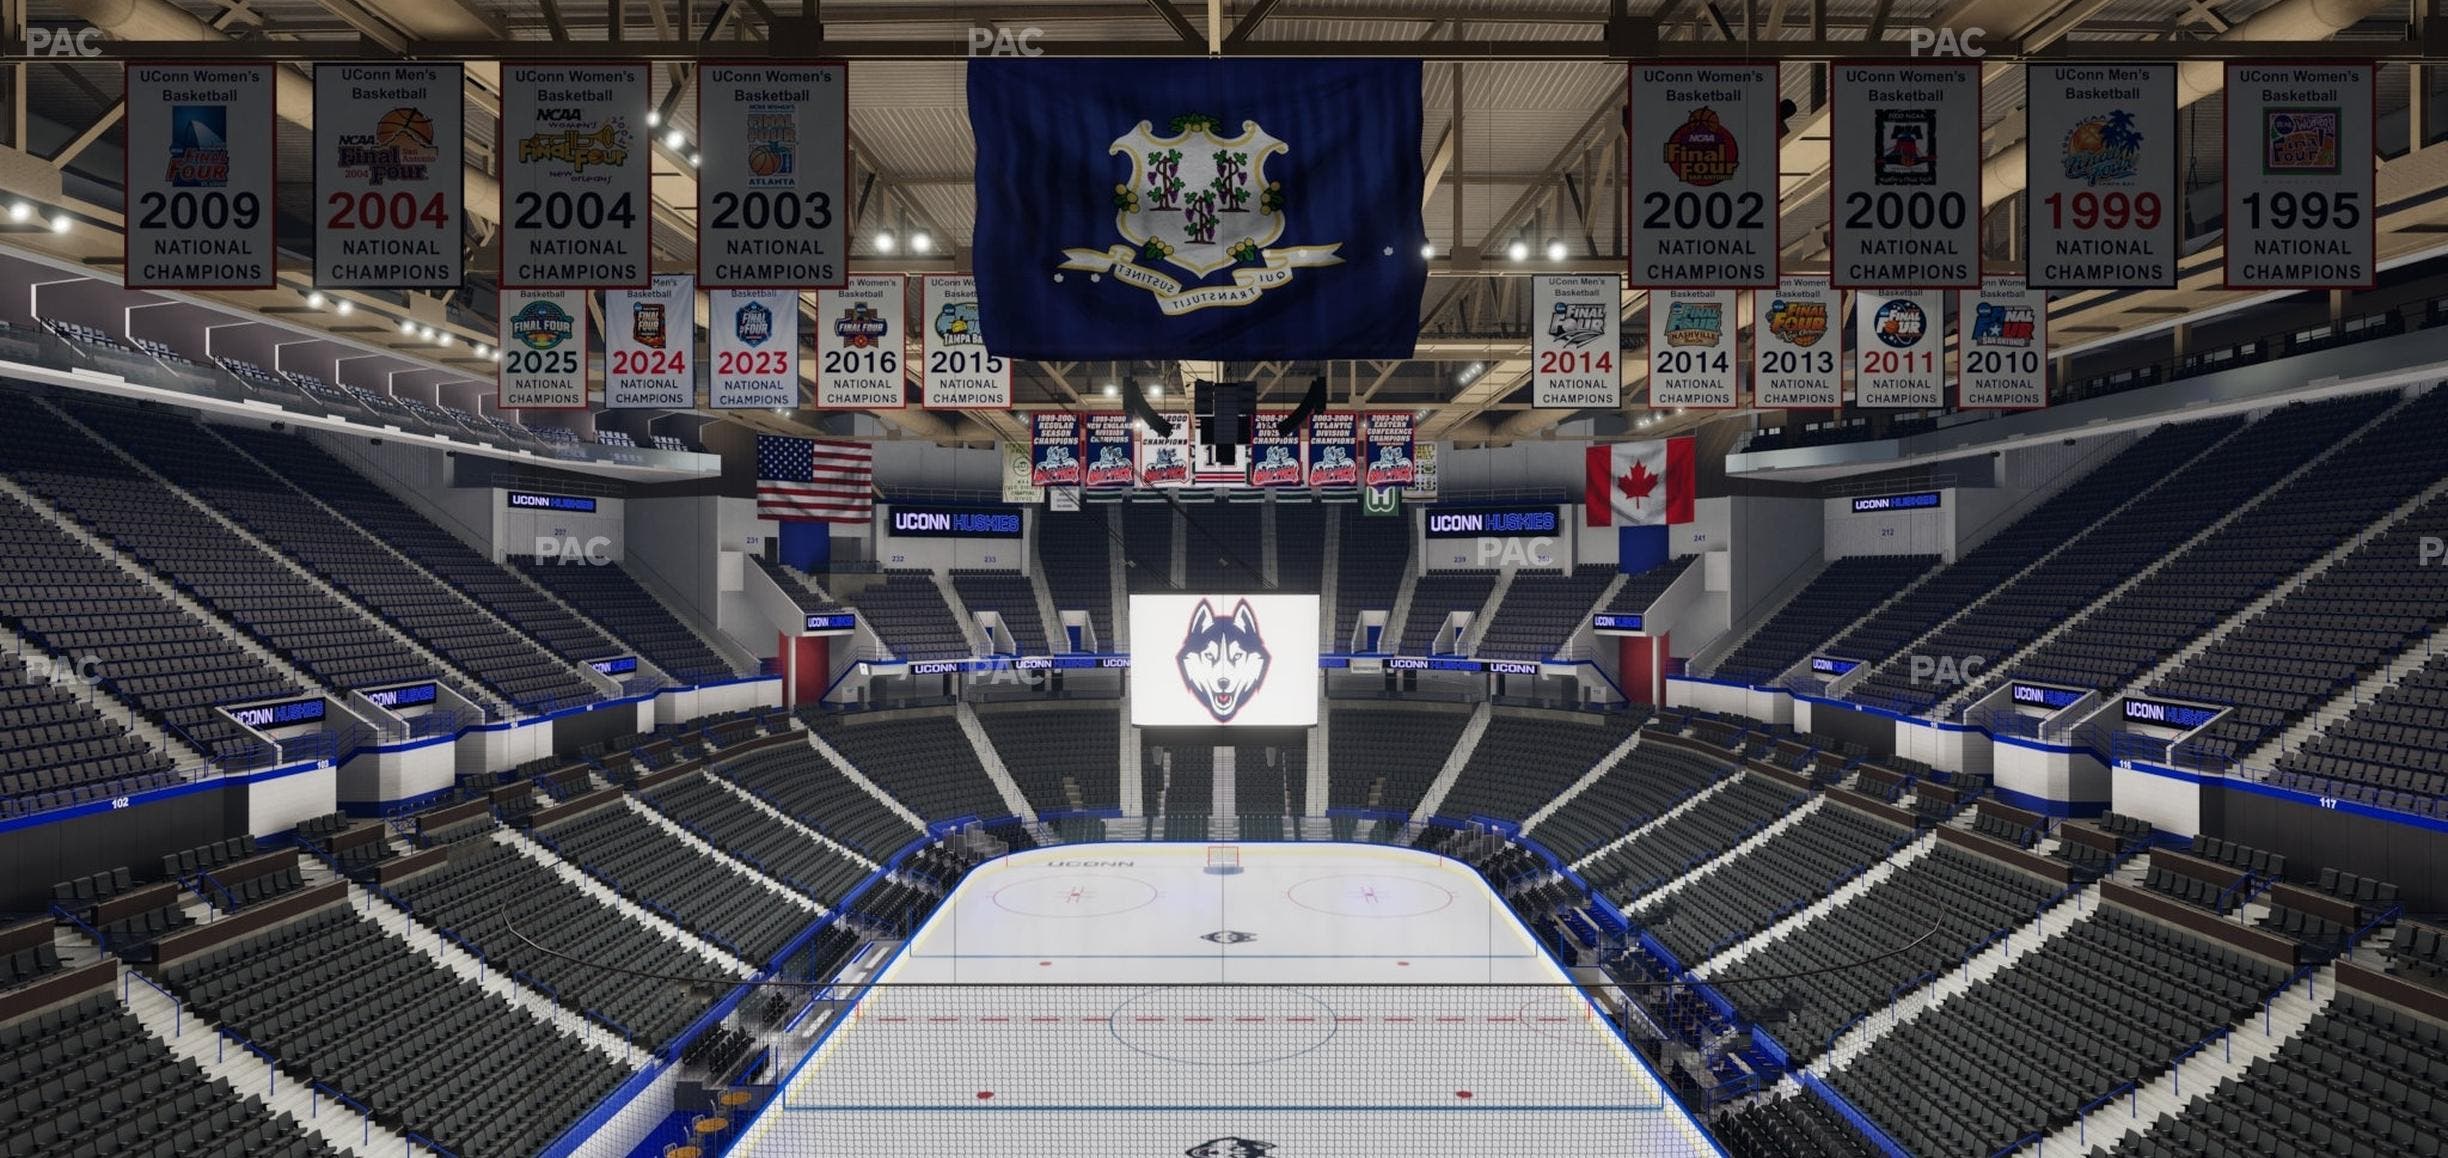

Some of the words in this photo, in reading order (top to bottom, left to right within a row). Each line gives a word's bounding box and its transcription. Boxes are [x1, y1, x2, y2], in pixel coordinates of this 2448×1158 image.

[140, 71, 188, 82] UConn
[194, 71, 259, 82] Women's
[342, 69, 390, 80] UConn
[396, 68, 436, 80] Men's
[516, 71, 564, 82] UConn
[569, 71, 635, 82] Women's
[713, 71, 761, 82] UConn
[766, 71, 831, 82] Women's
[1644, 71, 1692, 82] UConn
[1697, 71, 1763, 82] Women's
[1847, 71, 1895, 82] UConn
[1900, 71, 1965, 82] Women's
[2056, 68, 2103, 80] UConn
[2109, 69, 2149, 80] Men's
[2240, 71, 2288, 82] UConn
[2293, 70, 2359, 82] Women's
[163, 89, 237, 101] Basketball
[353, 88, 426, 99] Basketball
[538, 90, 612, 101] Basketball
[735, 90, 809, 102] Basketball
[1667, 90, 1740, 101] Basketball
[1869, 90, 1943, 101] Basketball
[2066, 88, 2139, 99] Basketball
[2263, 90, 2336, 101] Basketball
[537, 109, 581, 121] NCAA
[339, 135, 375, 146] NCAA
[338, 147, 399, 166] Final
[1669, 143, 1725, 162] Final
[166, 161, 228, 182] FOUR
[370, 166, 428, 185] Four
[1681, 162, 1738, 181] Four
[748, 178, 796, 186] ATLANTA
[140, 192, 259, 229] 2009
[328, 192, 448, 229] 2004
[515, 192, 635, 229] 2004
[712, 192, 831, 229] 2003
[1643, 192, 1763, 229] 2002
[1846, 191, 1965, 229] 2000
[2045, 192, 2161, 229] 1999
[2243, 192, 2359, 229] 1995
[155, 240, 252, 254] NATIONAL
[344, 240, 440, 255] NATIONAL
[531, 240, 627, 254] NATIONAL
[728, 240, 824, 254] NATIONAL
[1659, 240, 1755, 254] NATIONAL
[1861, 240, 1958, 255] NATIONAL
[2057, 240, 2153, 255] NATIONAL
[2255, 240, 2351, 254] NATIONAL
[144, 265, 260, 279] CHAMPIONS
[332, 265, 448, 279] CHAMPIONS
[519, 265, 636, 279] CHAMPIONS
[716, 265, 832, 279] CHAMPIONS
[1648, 265, 1764, 279] CHAMPIONS
[1850, 265, 1966, 279] CHAMPIONS
[2045, 265, 2162, 279] CHAMPIONS
[2243, 265, 2360, 279] CHAMPIONS
[732, 289, 776, 298] Basketball
[839, 290, 883, 298] Basketball
[1776, 290, 1820, 298] Basketball
[1980, 290, 2025, 298] Basketball
[638, 307, 660, 319] FINAL
[743, 311, 766, 324] FINAL
[514, 321, 540, 333] FINAL
[543, 321, 570, 333] FOUR
[637, 320, 659, 332] FOUR
[507, 351, 577, 373] 2025
[613, 351, 685, 374] 2024
[719, 352, 787, 374] 2023
[825, 351, 896, 373] 2016
[931, 350, 1003, 374] 2015
[1541, 351, 1612, 373] 2014
[1657, 351, 1728, 373] 2014
[1762, 351, 1833, 373] 2013
[1864, 350, 1934, 374] 2011
[1967, 351, 2038, 373] 2010
[516, 380, 573, 389] NATIONAL
[621, 379, 678, 388] NATIONAL
[725, 380, 783, 390] NATIONAL
[834, 379, 891, 388] NATIONAL
[940, 380, 997, 388] NATIONAL
[1550, 380, 1607, 388] NATIONAL
[1666, 379, 1724, 388] NATIONAL
[1771, 380, 1829, 388] NATIONAL
[1873, 379, 1930, 388] NATIONAL
[1976, 379, 2033, 389] NATIONAL
[509, 394, 578, 403] CHAMPIONS
[616, 394, 683, 403] CHAMPIONS
[720, 395, 788, 405] CHAMPIONS
[827, 394, 897, 403] CHAMPIONS
[933, 394, 1003, 403] CHAMPIONS
[1543, 394, 1613, 403] CHAMPIONS
[1660, 394, 1729, 403] CHAMPIONS
[1765, 394, 1834, 403] CHAMPIONS
[1867, 394, 1937, 403] CHAMPIONS
[1970, 394, 2039, 403] CHAMPIONS
[1034, 437, 1079, 445] CHAMPIONS
[1253, 437, 1298, 445] CHAMPIONS
[1311, 437, 1356, 445] CHAMPIONS
[513, 495, 549, 507] UCONN
[1855, 499, 1889, 510] UCONN
[896, 512, 950, 530] UCONN
[953, 514, 1019, 532] HUSKIES
[1430, 514, 1482, 532] UCONN
[1485, 512, 1554, 530] HUSKIES
[808, 617, 829, 628] UCONN
[1595, 617, 1615, 627] UCONN
[914, 663, 957, 674] UCONN
[1016, 660, 1052, 669] UCONN
[1390, 660, 1428, 669] UCONN
[1490, 663, 1535, 674] UCONN
[1813, 658, 1832, 671] UCONN
[2015, 686, 2043, 702] UCONN
[276, 701, 323, 722] HUSKIES
[2126, 702, 2164, 720] UCONN
[112, 797, 129, 809] 102
[2320, 798, 2337, 809] 117
